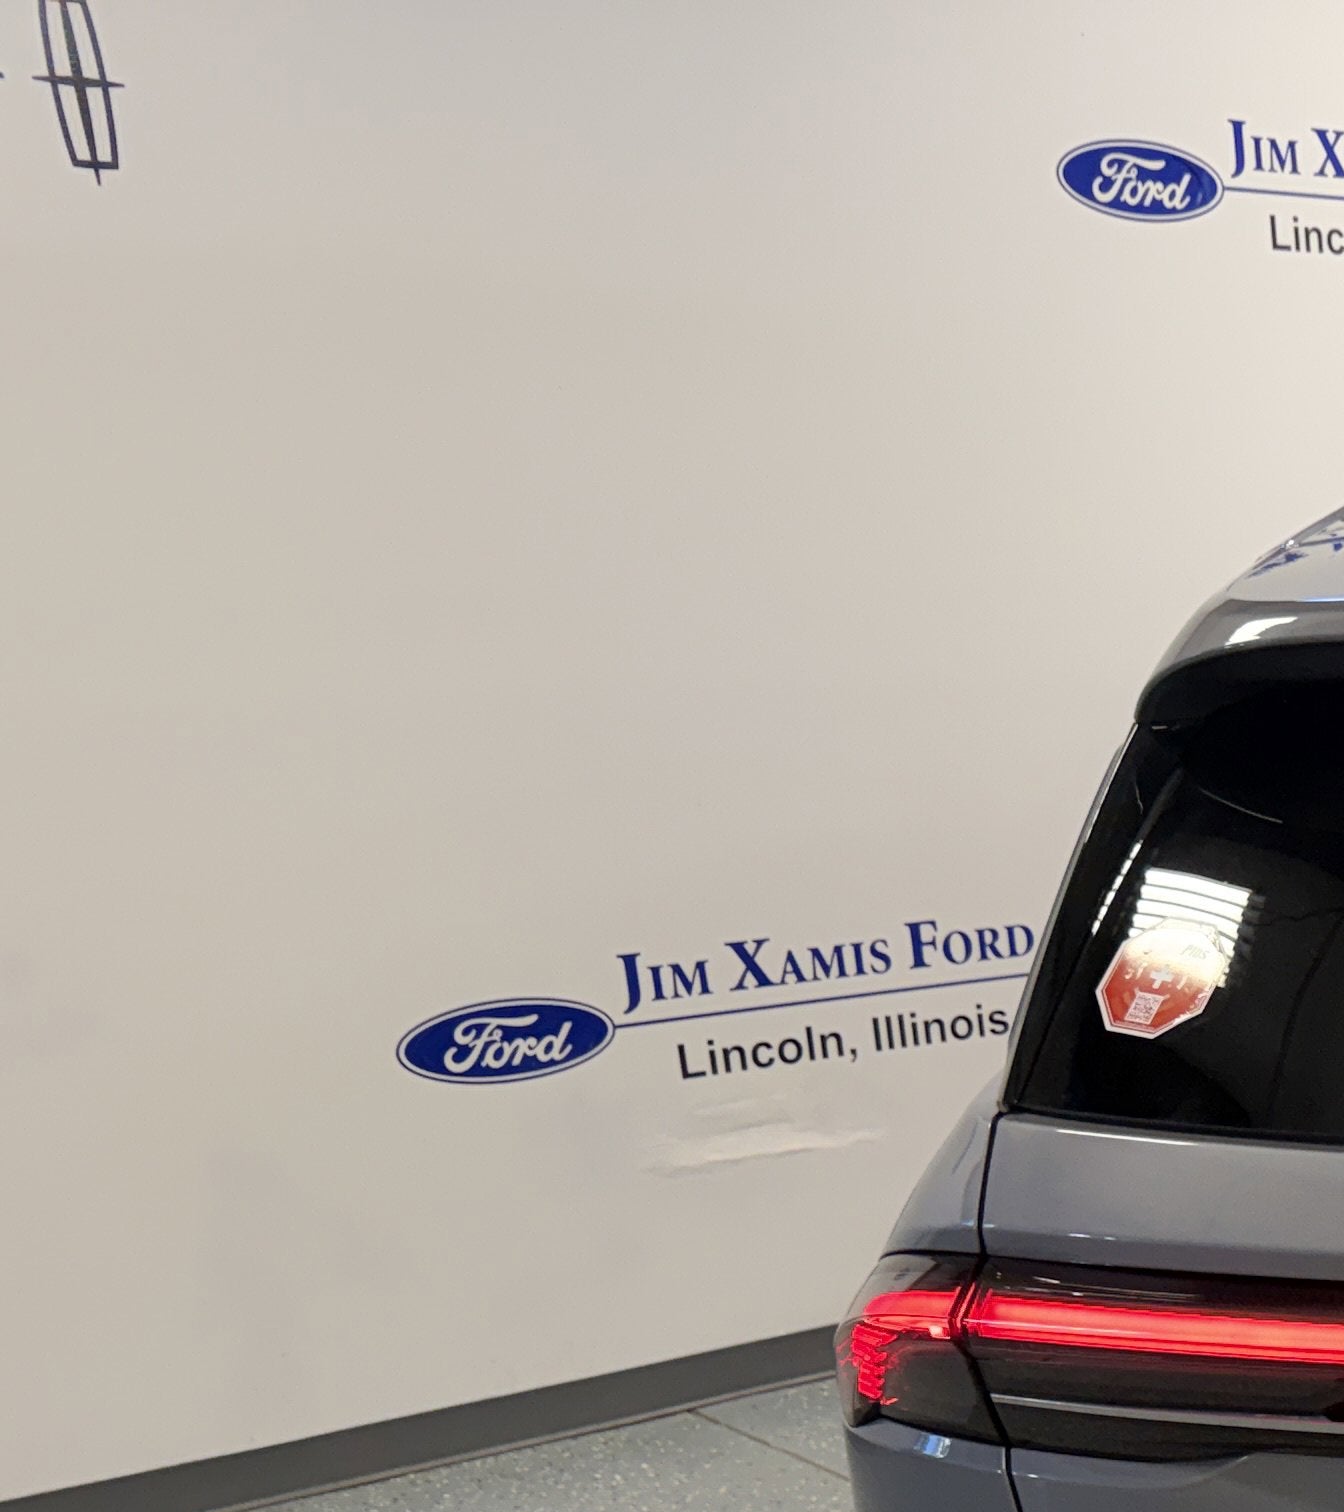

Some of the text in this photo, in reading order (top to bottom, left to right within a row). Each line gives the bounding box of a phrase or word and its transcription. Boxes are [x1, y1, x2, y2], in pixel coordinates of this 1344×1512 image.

[1227, 118, 1302, 180] JIM
[1091, 152, 1192, 211] Ford
[615, 919, 1035, 1016] JIM XAMIS FORD
[443, 1013, 574, 1074] Ford
[676, 1002, 1010, 1081] Lincoln, Illinois
